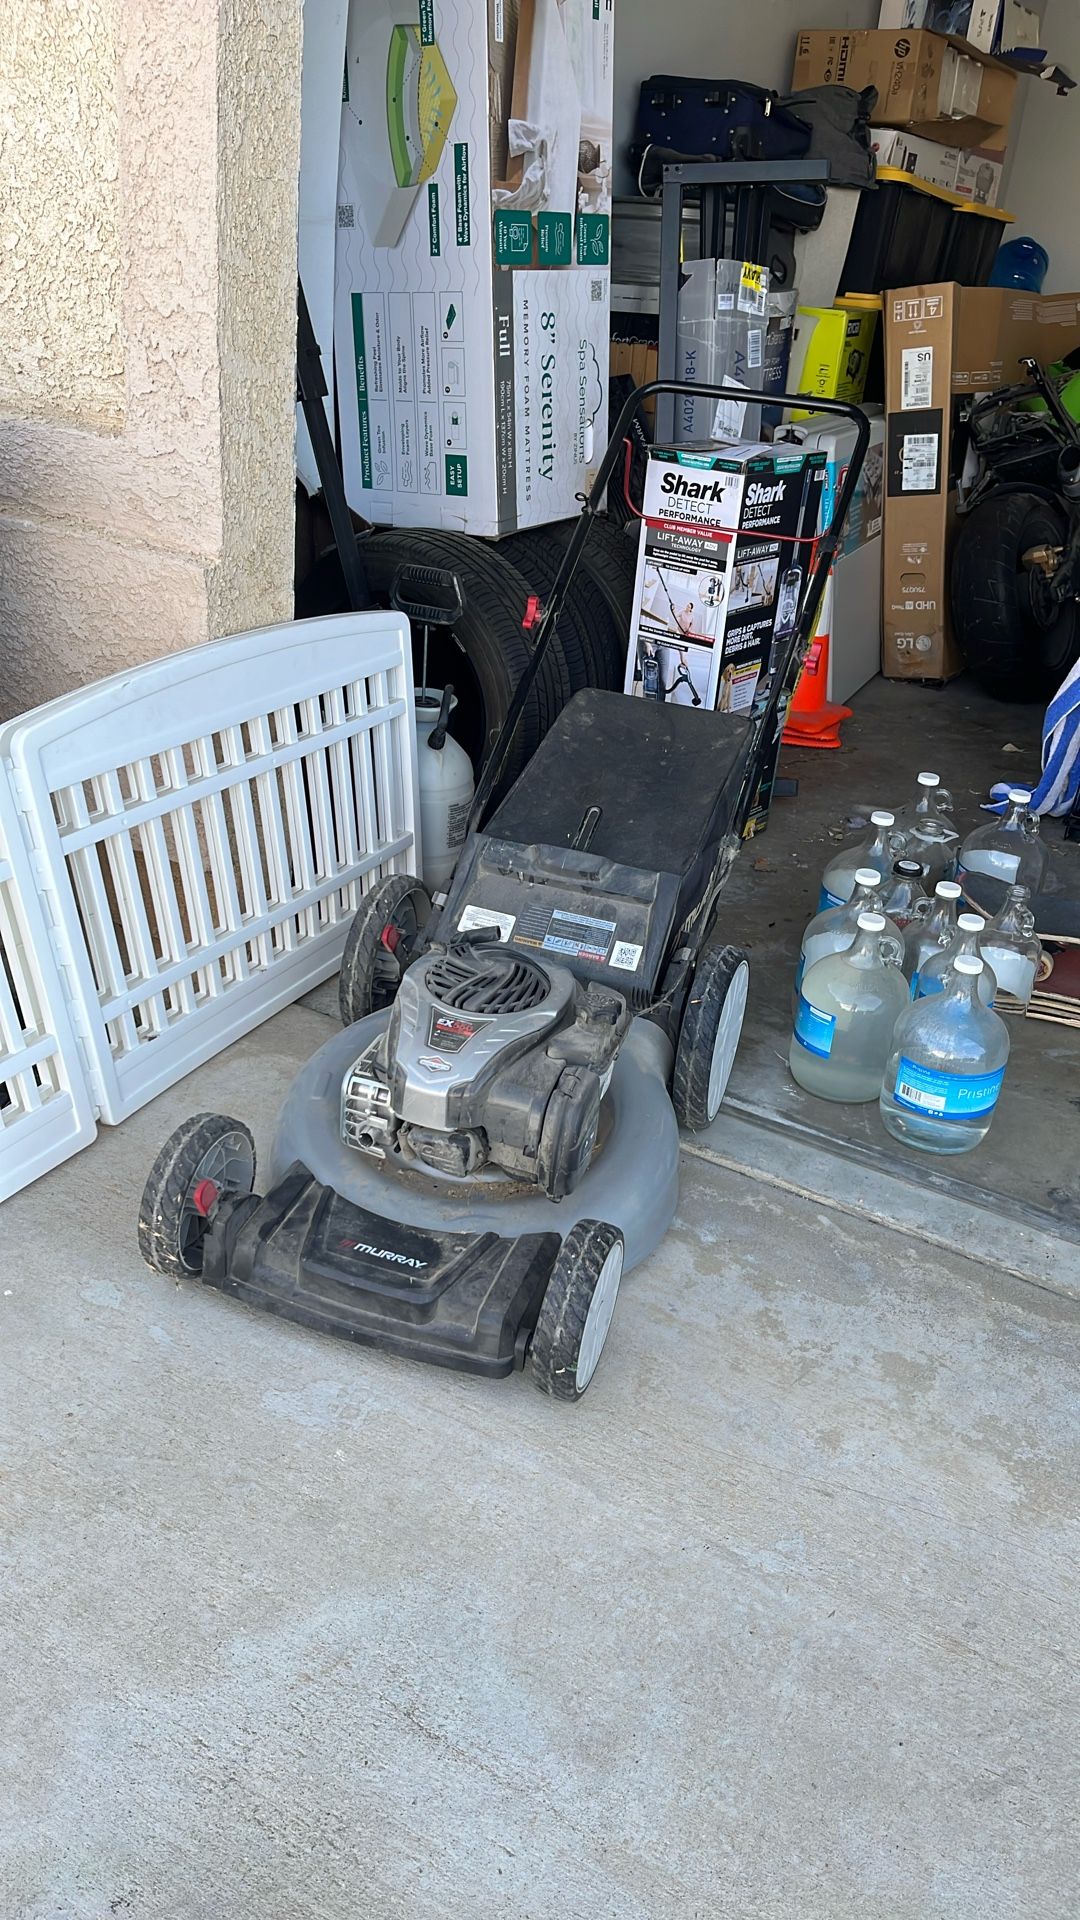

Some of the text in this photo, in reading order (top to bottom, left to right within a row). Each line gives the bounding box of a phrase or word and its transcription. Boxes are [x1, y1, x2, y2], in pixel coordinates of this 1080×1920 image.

[895, 39, 911, 58] hp
[838, 37, 850, 82] HDMI
[499, 315, 511, 357] Full
[917, 352, 931, 362] US
[357, 356, 366, 391] Benefits
[683, 350, 696, 433] A40218-K
[578, 340, 588, 464] Spa Sensations
[538, 354, 557, 481] Serenity
[360, 411, 371, 481] Product Features
[660, 472, 726, 503] Shark
[745, 480, 787, 506] Shark
[668, 496, 713, 514] DETECT
[743, 504, 773, 519] DETECT
[658, 508, 722, 527] PERFORMANCE
[742, 515, 781, 529] PERFORMANCE
[657, 532, 704, 548] LIFT-AWAY
[677, 526, 696, 534] MEMBER
[697, 530, 713, 538] VALUE
[671, 543, 702, 553] TECHNOLOGY
[737, 545, 769, 559] LIFT-AWAY
[915, 601, 936, 610] UHD
[727, 627, 742, 638] GRIPS
[747, 619, 773, 632] CAPTURES
[724, 642, 743, 654] DEBRIS
[726, 635, 741, 646] MORE
[897, 638, 914, 649] LG
[353, 1243, 428, 1269] MURRAY
